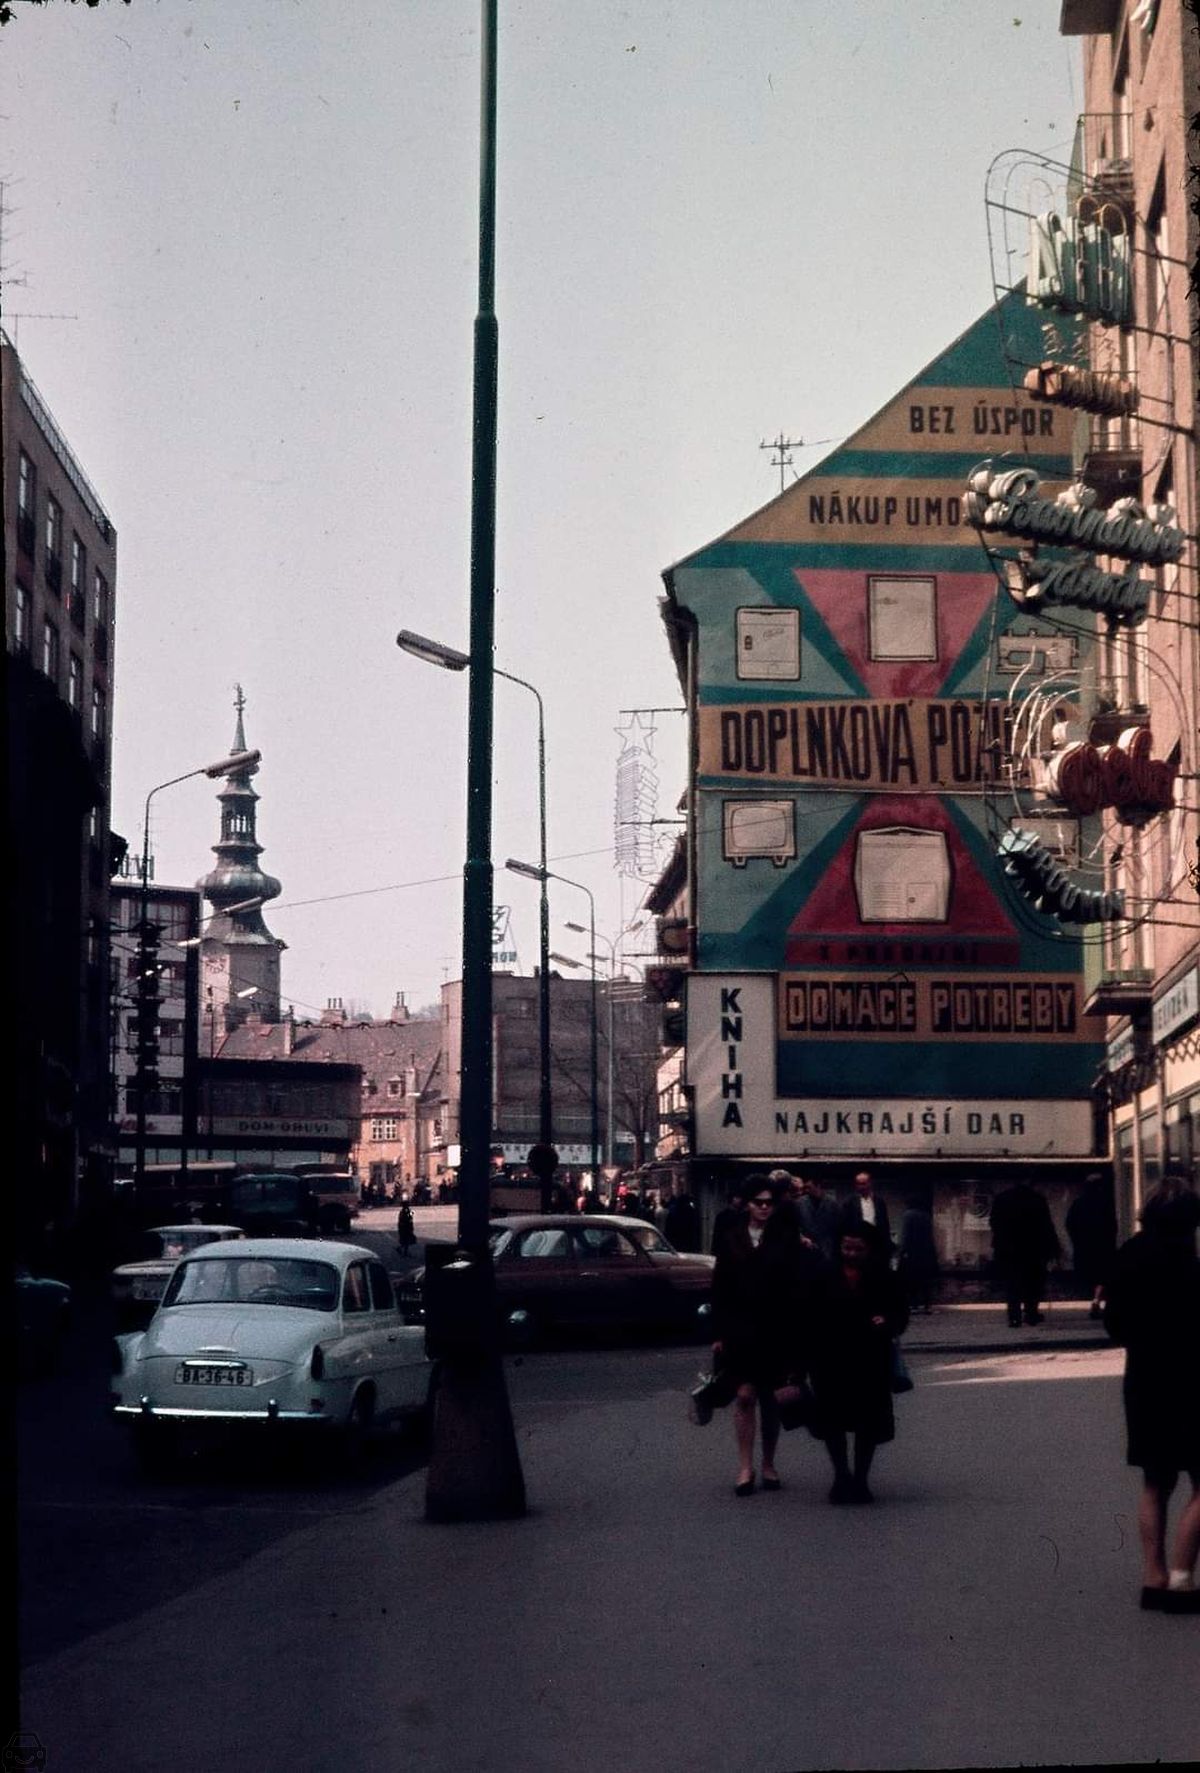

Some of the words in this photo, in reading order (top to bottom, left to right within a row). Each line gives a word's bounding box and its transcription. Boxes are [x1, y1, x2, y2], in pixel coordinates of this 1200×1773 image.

[910, 405, 955, 433] BEZ
[973, 400, 1054, 436] ÚSPOR
[809, 490, 898, 525] NÁKUP
[907, 496, 962, 526] UMO
[720, 700, 919, 784] DOPLNKOVÁ
[931, 982, 1076, 1032] POTREBY
[720, 988, 743, 1128] KNIHA
[238, 1121, 273, 1132] DOM
[775, 1107, 952, 1135] NAJKRAJŠÍ
[967, 1112, 1025, 1135] DAR
